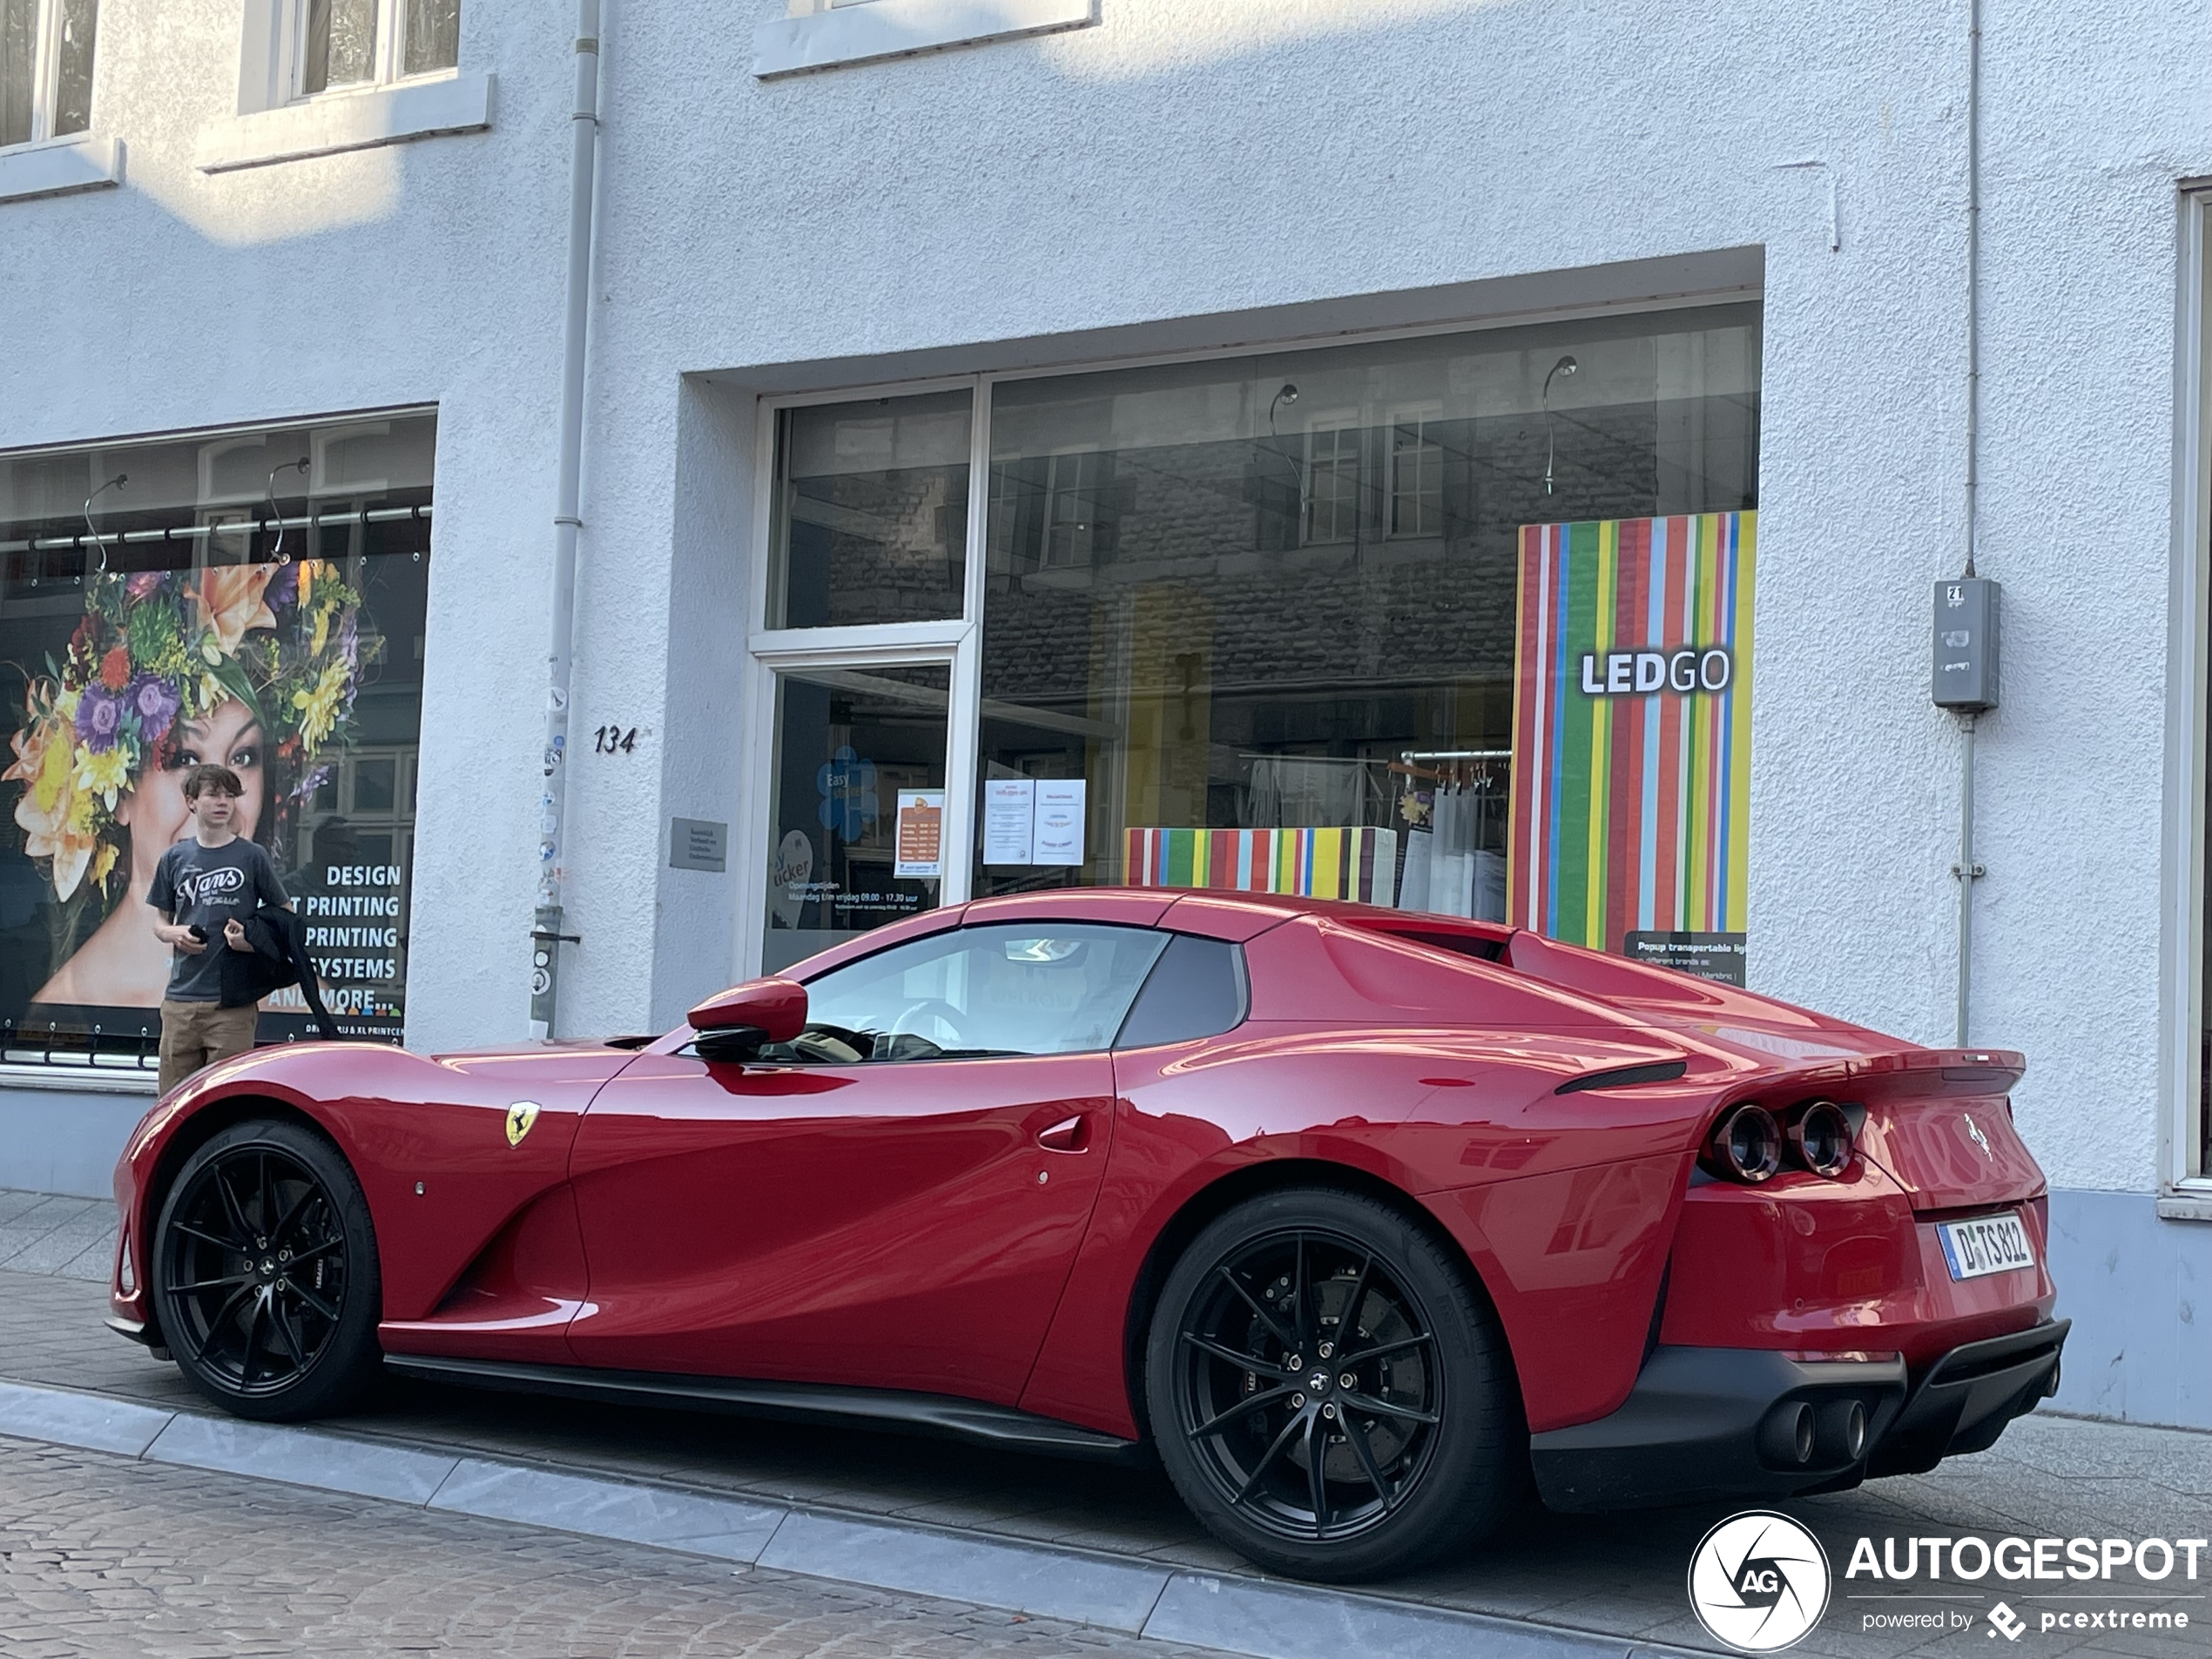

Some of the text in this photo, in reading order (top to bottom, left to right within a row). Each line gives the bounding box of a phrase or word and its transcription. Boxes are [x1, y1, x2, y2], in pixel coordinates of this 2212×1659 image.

[1582, 650, 1730, 693] LEDGO
[595, 725, 636, 753] 134
[827, 773, 849, 787] Easy
[327, 866, 401, 886] DESIGN
[177, 868, 240, 906] Vans
[307, 896, 399, 916] PRINTING
[305, 927, 397, 948] PRINTING
[1669, 943, 1731, 954] transportable
